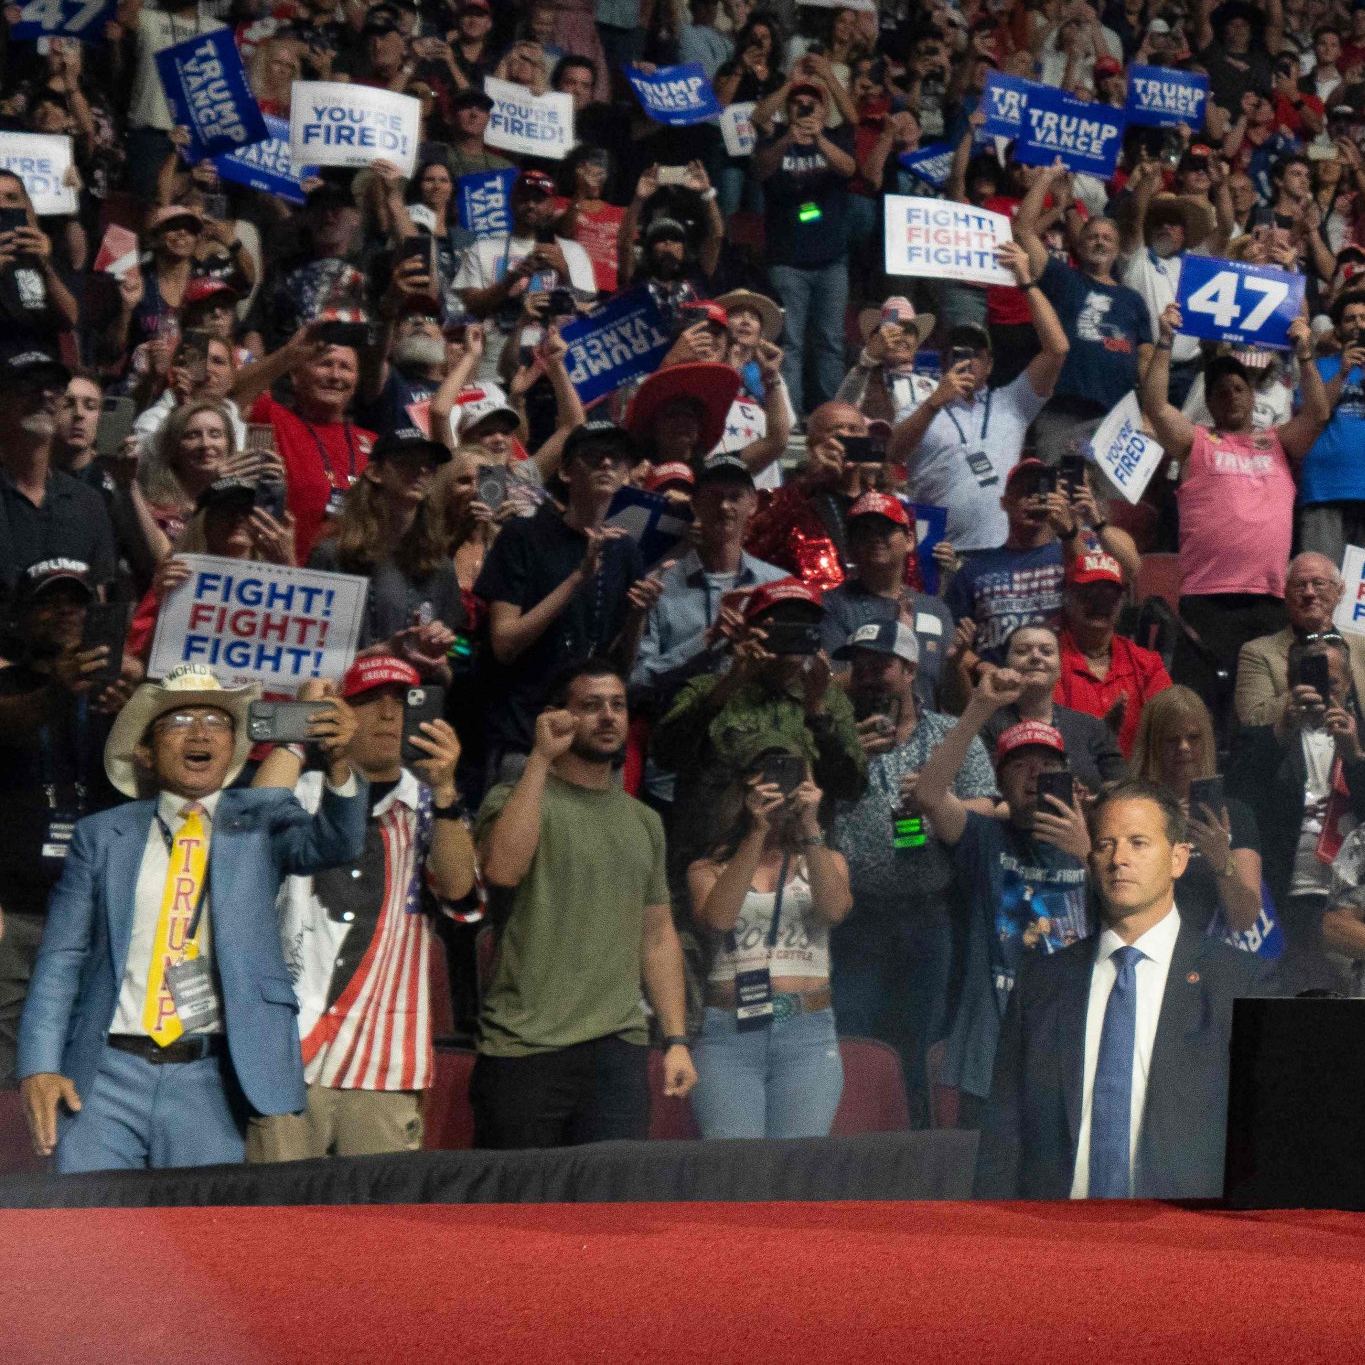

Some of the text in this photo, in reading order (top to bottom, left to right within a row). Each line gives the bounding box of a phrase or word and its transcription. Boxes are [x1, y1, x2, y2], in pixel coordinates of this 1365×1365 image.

[181, 55, 222, 139] VANCE
[195, 39, 248, 143] TRUMP
[632, 76, 702, 99] TRUMP
[1133, 78, 1206, 102] TRUMP
[1141, 93, 1198, 114] VANCE
[312, 106, 403, 131] YOU'RE
[490, 113, 564, 143] FIRED!
[494, 100, 558, 124] YOU'RE
[1028, 108, 1119, 142] TRUMP
[302, 123, 408, 156] FIRED!
[1033, 126, 1106, 155] VANCE
[906, 208, 994, 232] FIGHT!
[906, 227, 999, 250] FIGHT!
[907, 246, 998, 270] FIGHT!
[1187, 270, 1289, 332] 47
[569, 317, 650, 363] VANCE
[570, 326, 669, 385] TRUMP
[1107, 419, 1135, 461] YOU'RE
[1113, 430, 1150, 485] FIRED!
[194, 573, 335, 617] FIGHT!
[188, 602, 330, 648] FIGHT!
[182, 634, 323, 677] FIGHT!
[166, 664, 207, 681] WORLD
